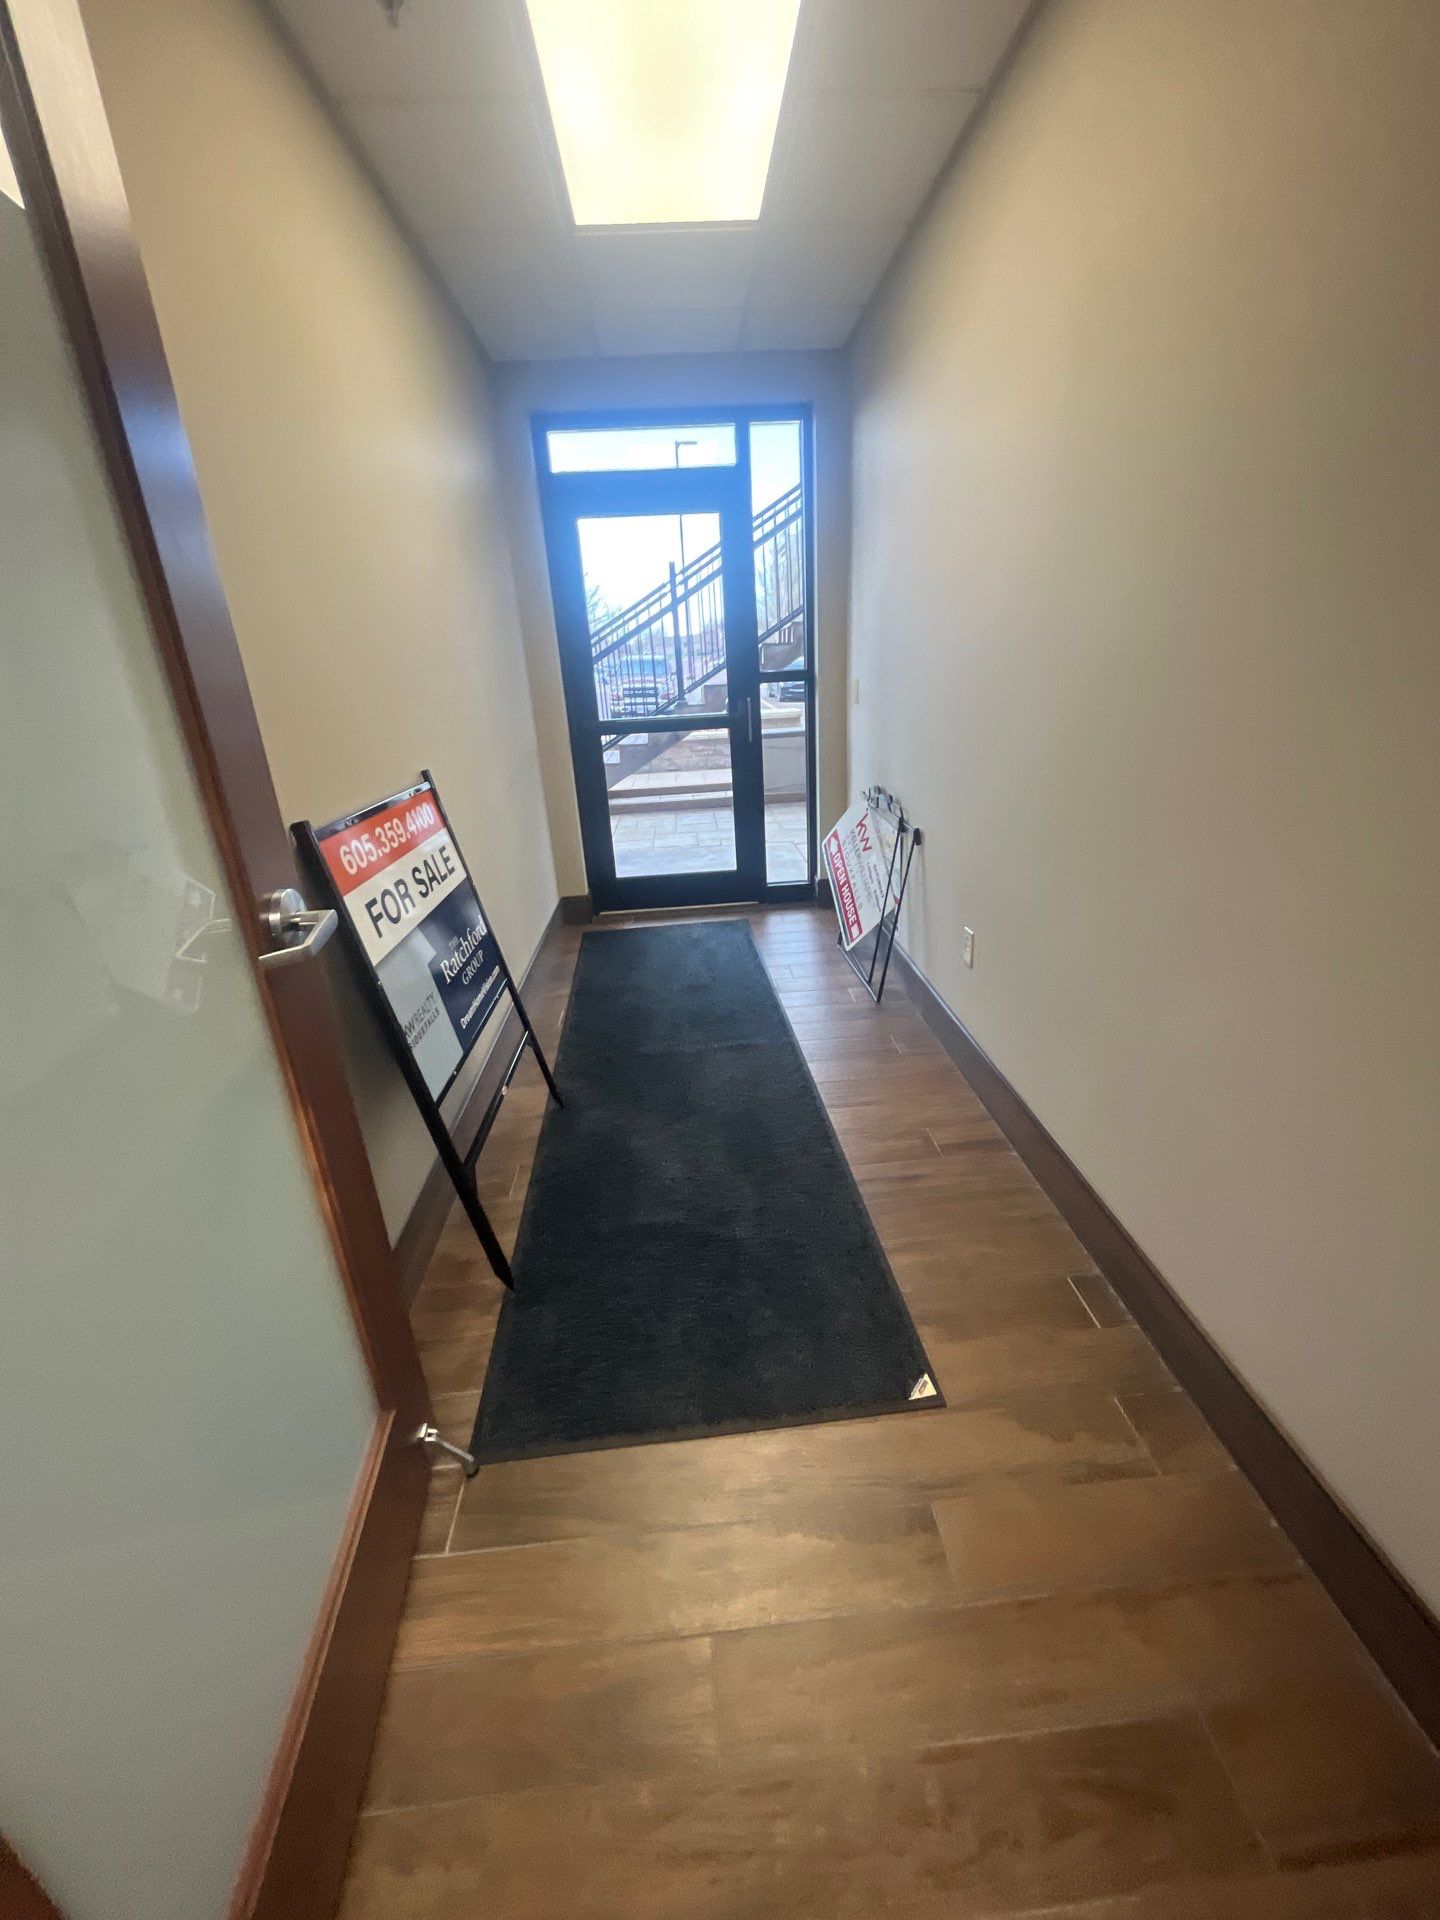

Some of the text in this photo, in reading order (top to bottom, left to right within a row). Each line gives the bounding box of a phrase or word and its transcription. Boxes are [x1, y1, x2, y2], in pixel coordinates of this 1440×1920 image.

[339, 802, 435, 875] 605.359.4100
[364, 845, 456, 939] FOR SALE
[833, 854, 846, 886] OPEN
[841, 886, 858, 927] HOUSE
[440, 914, 488, 985] Ratchford
[461, 949, 485, 985] GROUP
